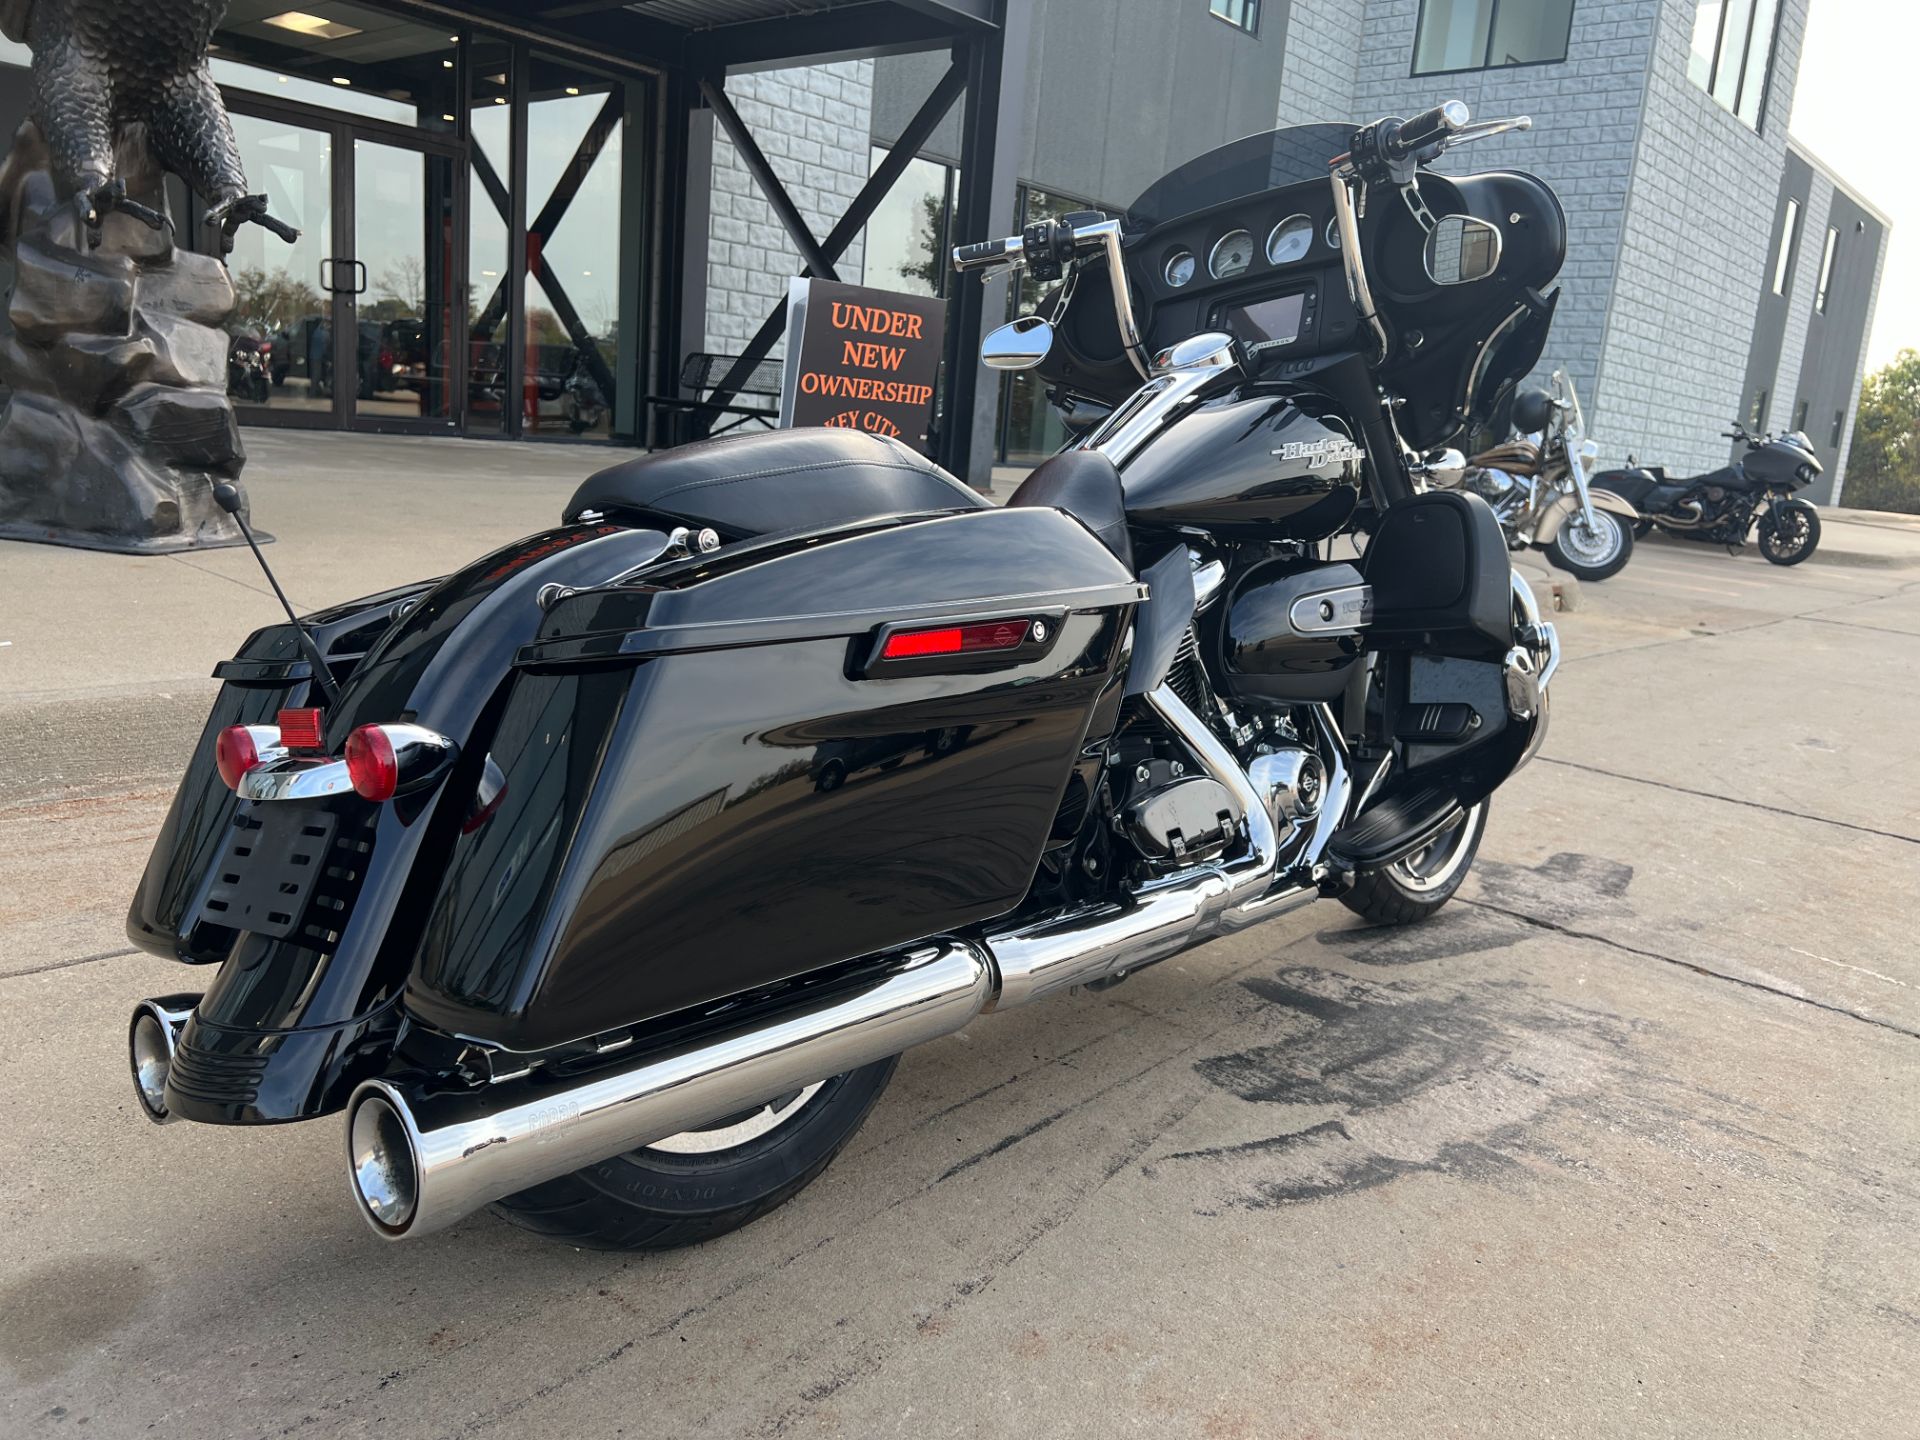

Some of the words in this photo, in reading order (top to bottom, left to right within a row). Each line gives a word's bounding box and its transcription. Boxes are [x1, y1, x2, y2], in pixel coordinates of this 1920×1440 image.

[832, 302, 922, 339] UNDER
[841, 341, 907, 371] NEW
[801, 373, 933, 405] OWNERSHIP
[864, 412, 900, 438] CITY
[626, 1180, 718, 1201] DUNLOP
